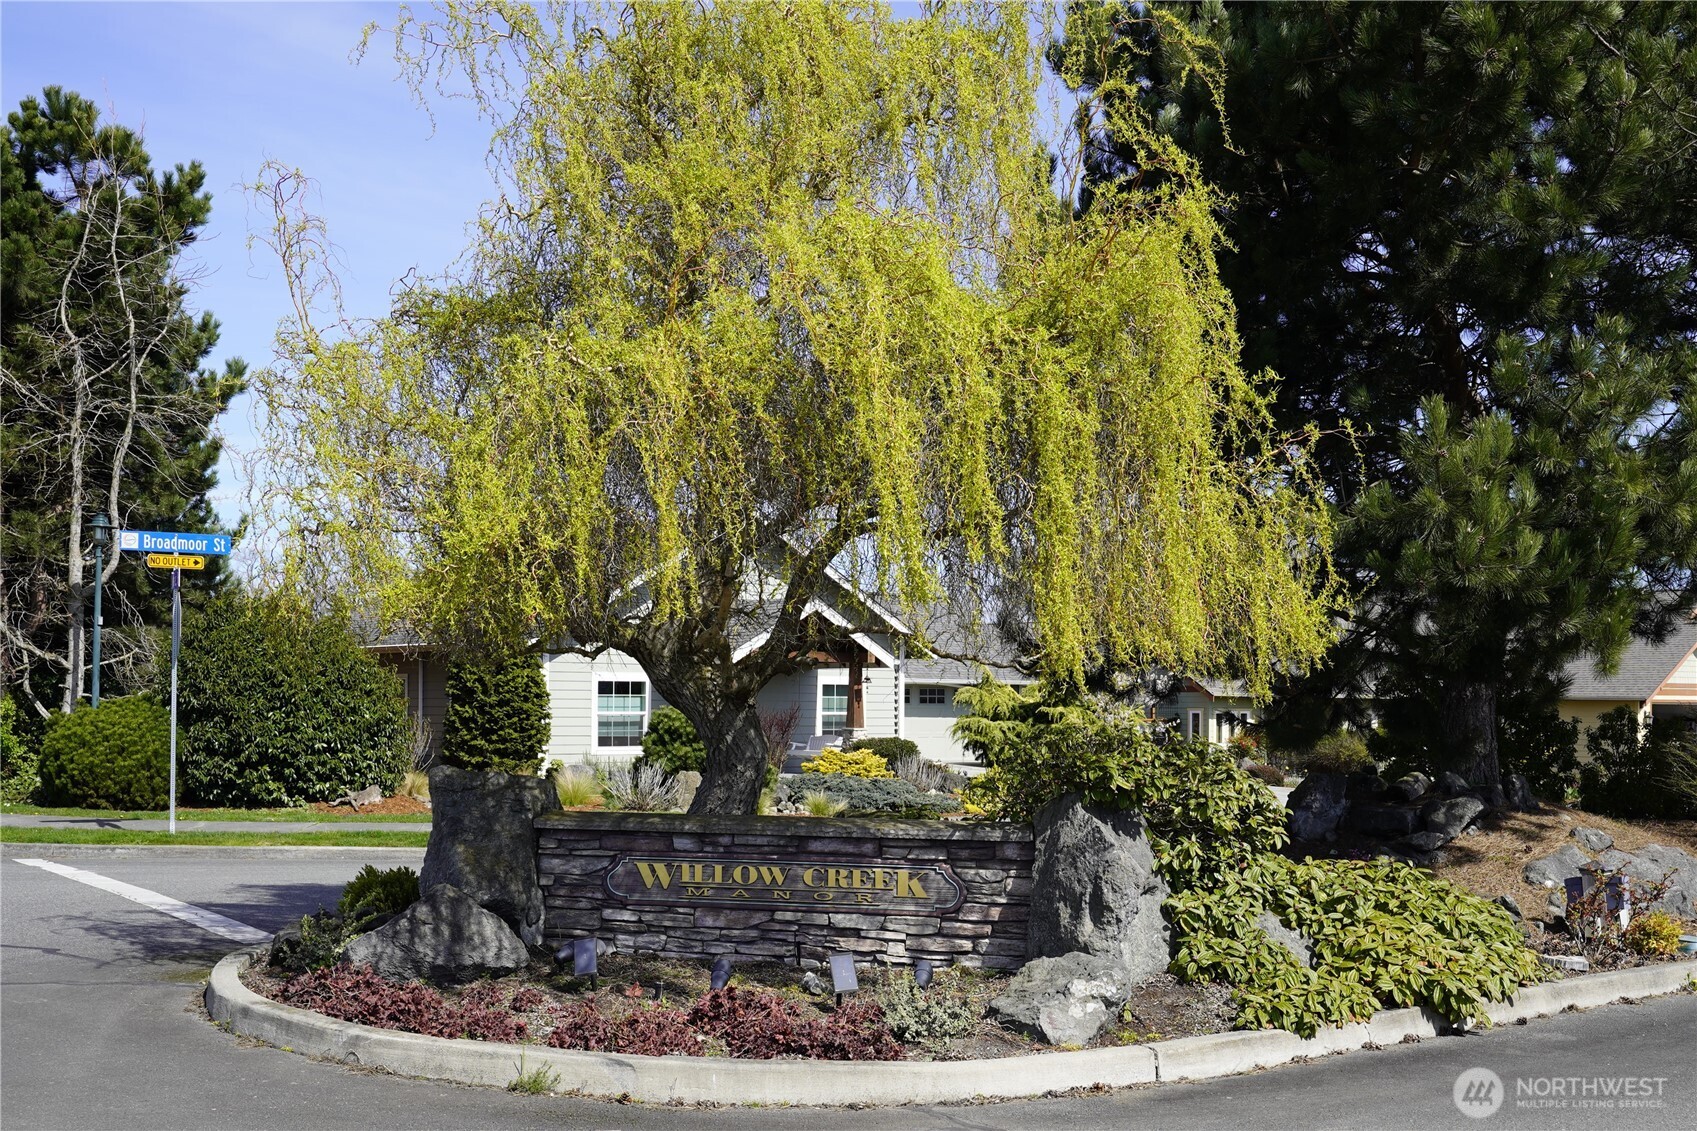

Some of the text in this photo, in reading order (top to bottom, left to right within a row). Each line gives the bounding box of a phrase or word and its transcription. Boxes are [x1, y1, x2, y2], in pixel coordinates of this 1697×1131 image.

[143, 534, 226, 552] Broadmoor St
[150, 556, 191, 566] NO OUTLET
[634, 861, 931, 899] WILLOW CREEK
[685, 887, 875, 903] MANOR
